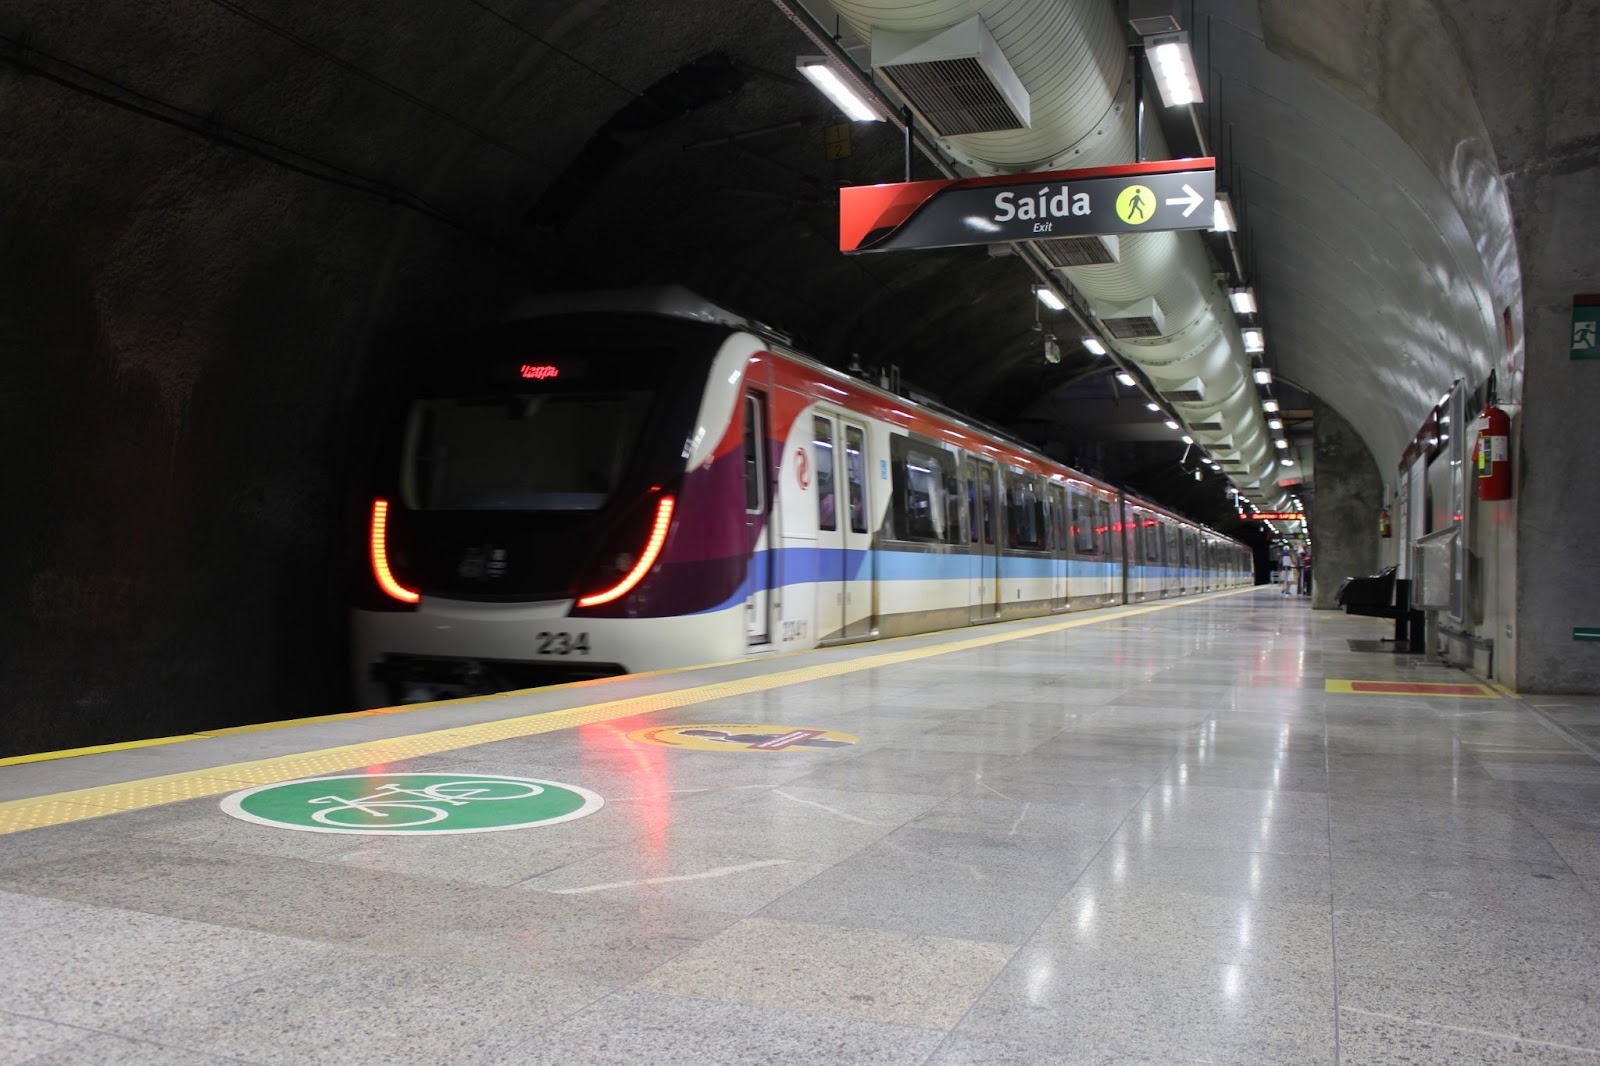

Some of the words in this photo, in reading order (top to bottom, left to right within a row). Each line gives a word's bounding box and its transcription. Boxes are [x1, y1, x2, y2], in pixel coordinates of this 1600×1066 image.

[833, 143, 843, 157] 2
[994, 186, 1091, 221] Saída
[1033, 222, 1053, 233] Exit
[536, 631, 591, 656] 234
